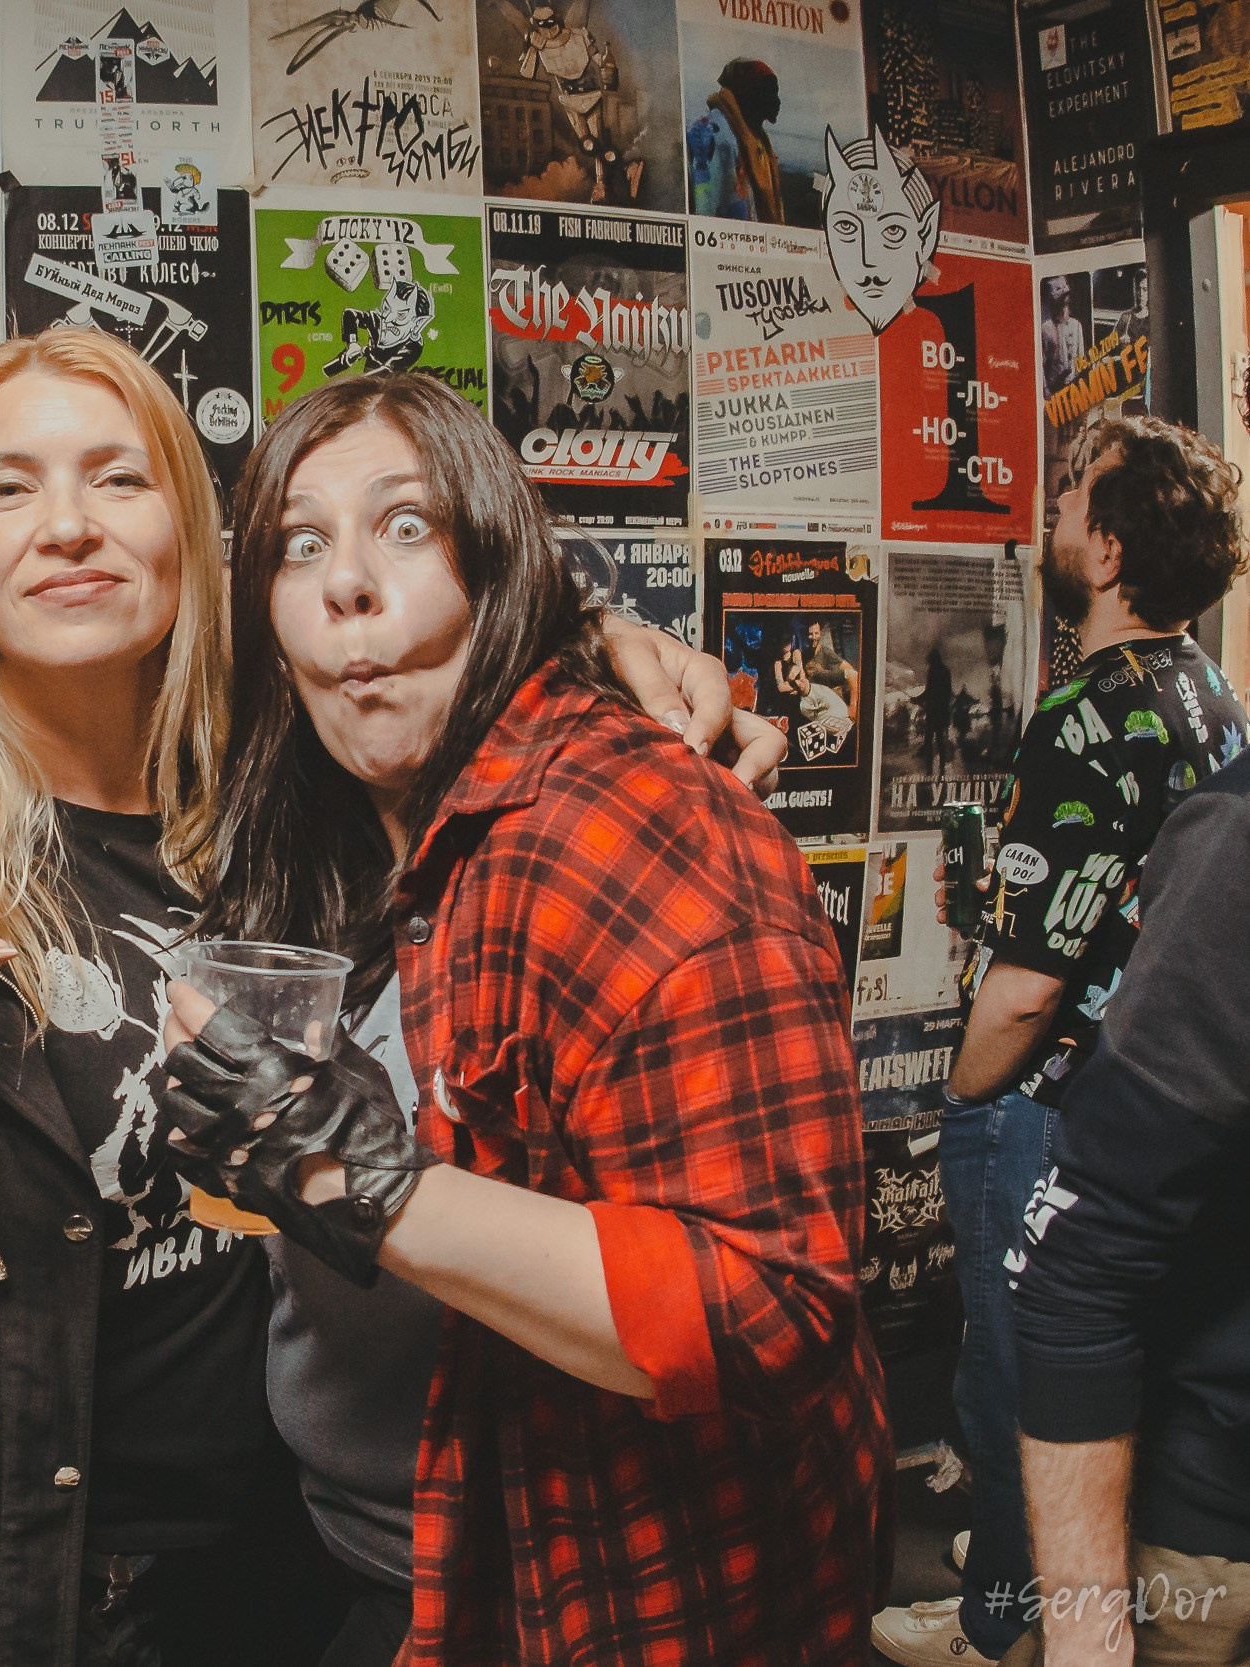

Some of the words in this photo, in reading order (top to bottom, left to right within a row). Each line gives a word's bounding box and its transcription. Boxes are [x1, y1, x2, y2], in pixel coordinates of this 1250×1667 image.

[718, 0, 824, 34] VIBRATION
[1070, 31, 1099, 51] THE
[1046, 52, 1126, 90] ELOVITSKY
[1049, 80, 1129, 118] EXPERIMENT
[136, 120, 221, 132] ORTH
[1054, 143, 1135, 175] ALEJANDRO
[1055, 170, 1136, 201] RIVERA
[37, 213, 79, 231] 08.12
[493, 212, 541, 235] 08.11.19
[559, 216, 582, 238] FISH
[585, 219, 632, 243] FABRIQUE
[635, 223, 684, 247] NOUVELLE
[695, 230, 718, 248] 06
[719, 232, 765, 244] ОКТЯБРЯ
[103, 250, 152, 264] CALLING
[717, 263, 762, 274] ФИНСКАЯ
[488, 264, 570, 343] The
[716, 276, 811, 312] TUSOVKA
[271, 343, 306, 394] 9
[707, 339, 826, 376] PIETARIN
[921, 340, 965, 370] ВО-
[411, 366, 488, 390] ECIAL
[727, 362, 858, 393] SPEKTAAKKELI
[715, 392, 790, 419] JUKKA
[956, 380, 1008, 410] -ЛЬ-
[729, 407, 835, 436] NOUSIAINEN
[913, 416, 967, 446] -НО-
[580, 469, 621, 478] MANIACS
[729, 454, 762, 472] THE
[739, 460, 838, 489] SLOPTONES
[957, 455, 1014, 485] -СТЬ
[613, 543, 626, 564] 4
[630, 543, 689, 564] ЯНВАРЯ
[646, 567, 693, 588] 20:00
[762, 790, 787, 809] CIAL
[891, 783, 918, 807] НА
[931, 780, 1001, 807] УЛИЦУ
[1005, 849, 1040, 867] CAAAN
[1012, 866, 1035, 881] DO!
[936, 1018, 964, 1030] МАРТ
